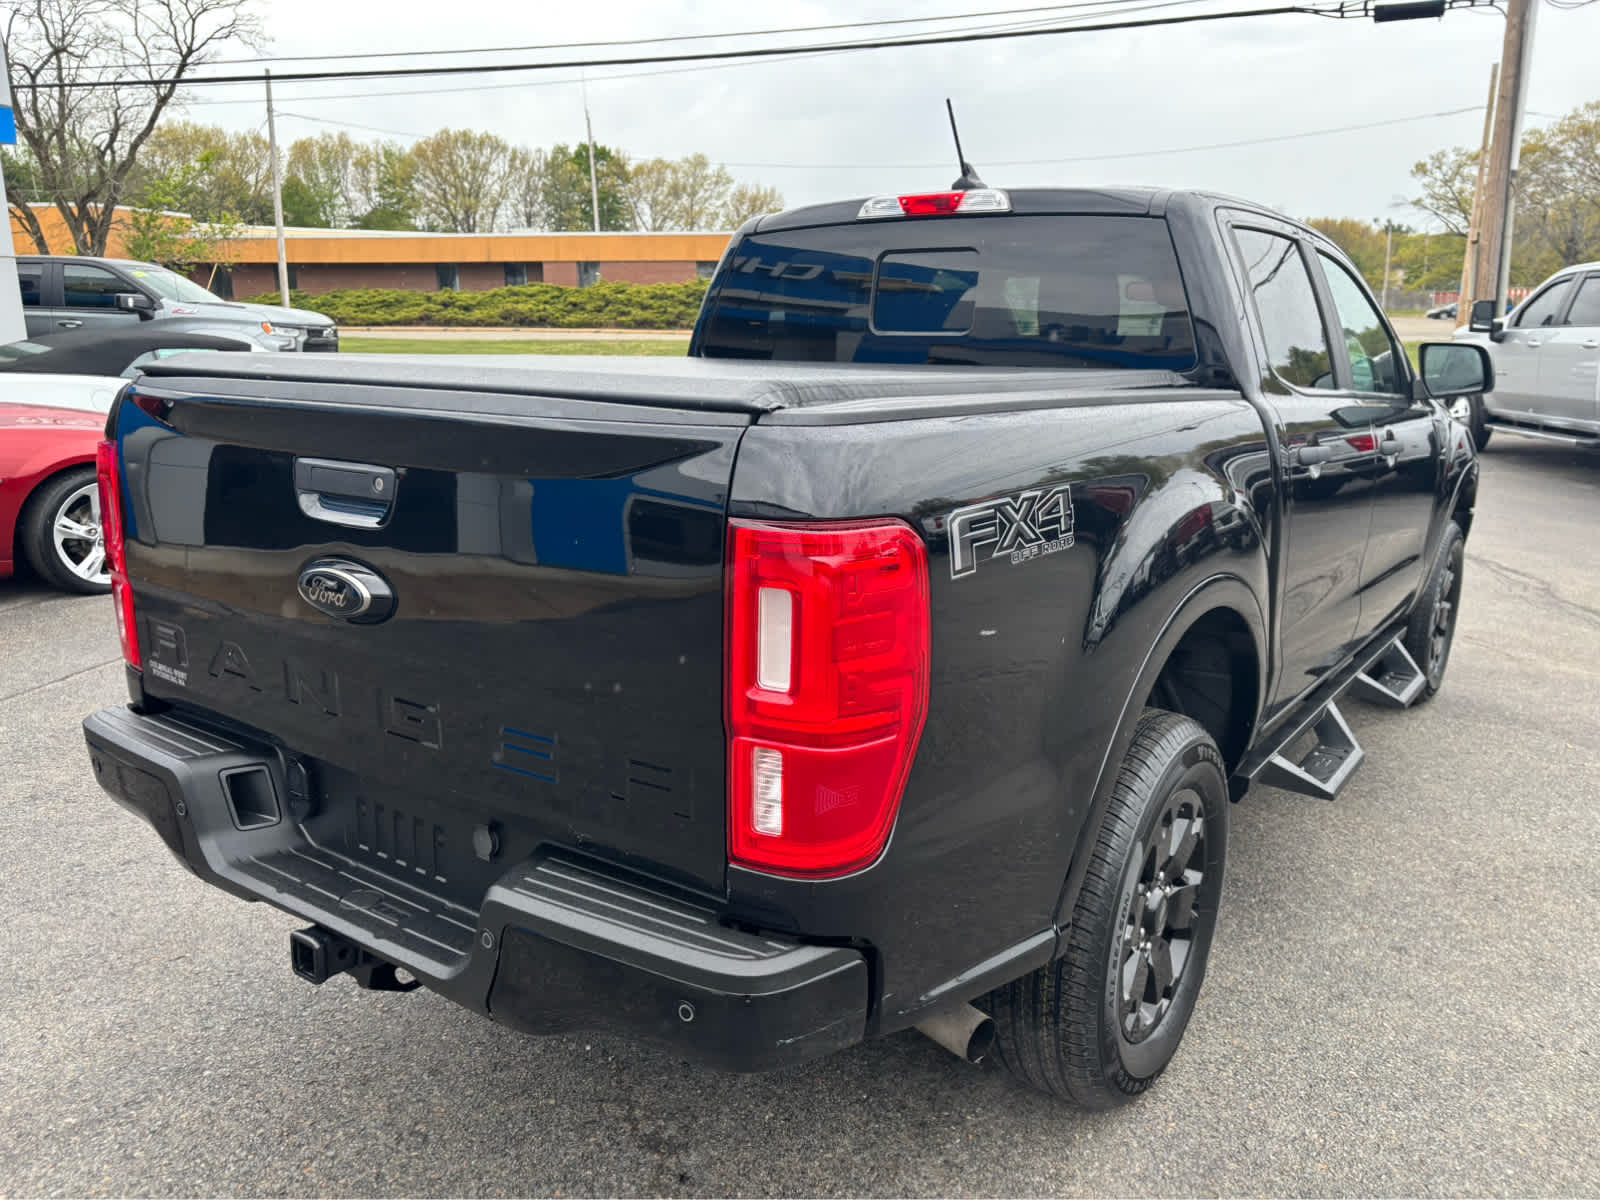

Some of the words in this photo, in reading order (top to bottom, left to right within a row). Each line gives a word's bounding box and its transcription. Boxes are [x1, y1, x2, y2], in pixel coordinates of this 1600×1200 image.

[947, 485, 1074, 580] FX4
[1011, 546, 1038, 564] OFF
[1041, 536, 1074, 555] ROAD
[308, 575, 347, 607] Ford
[146, 616, 694, 820] RANGER
